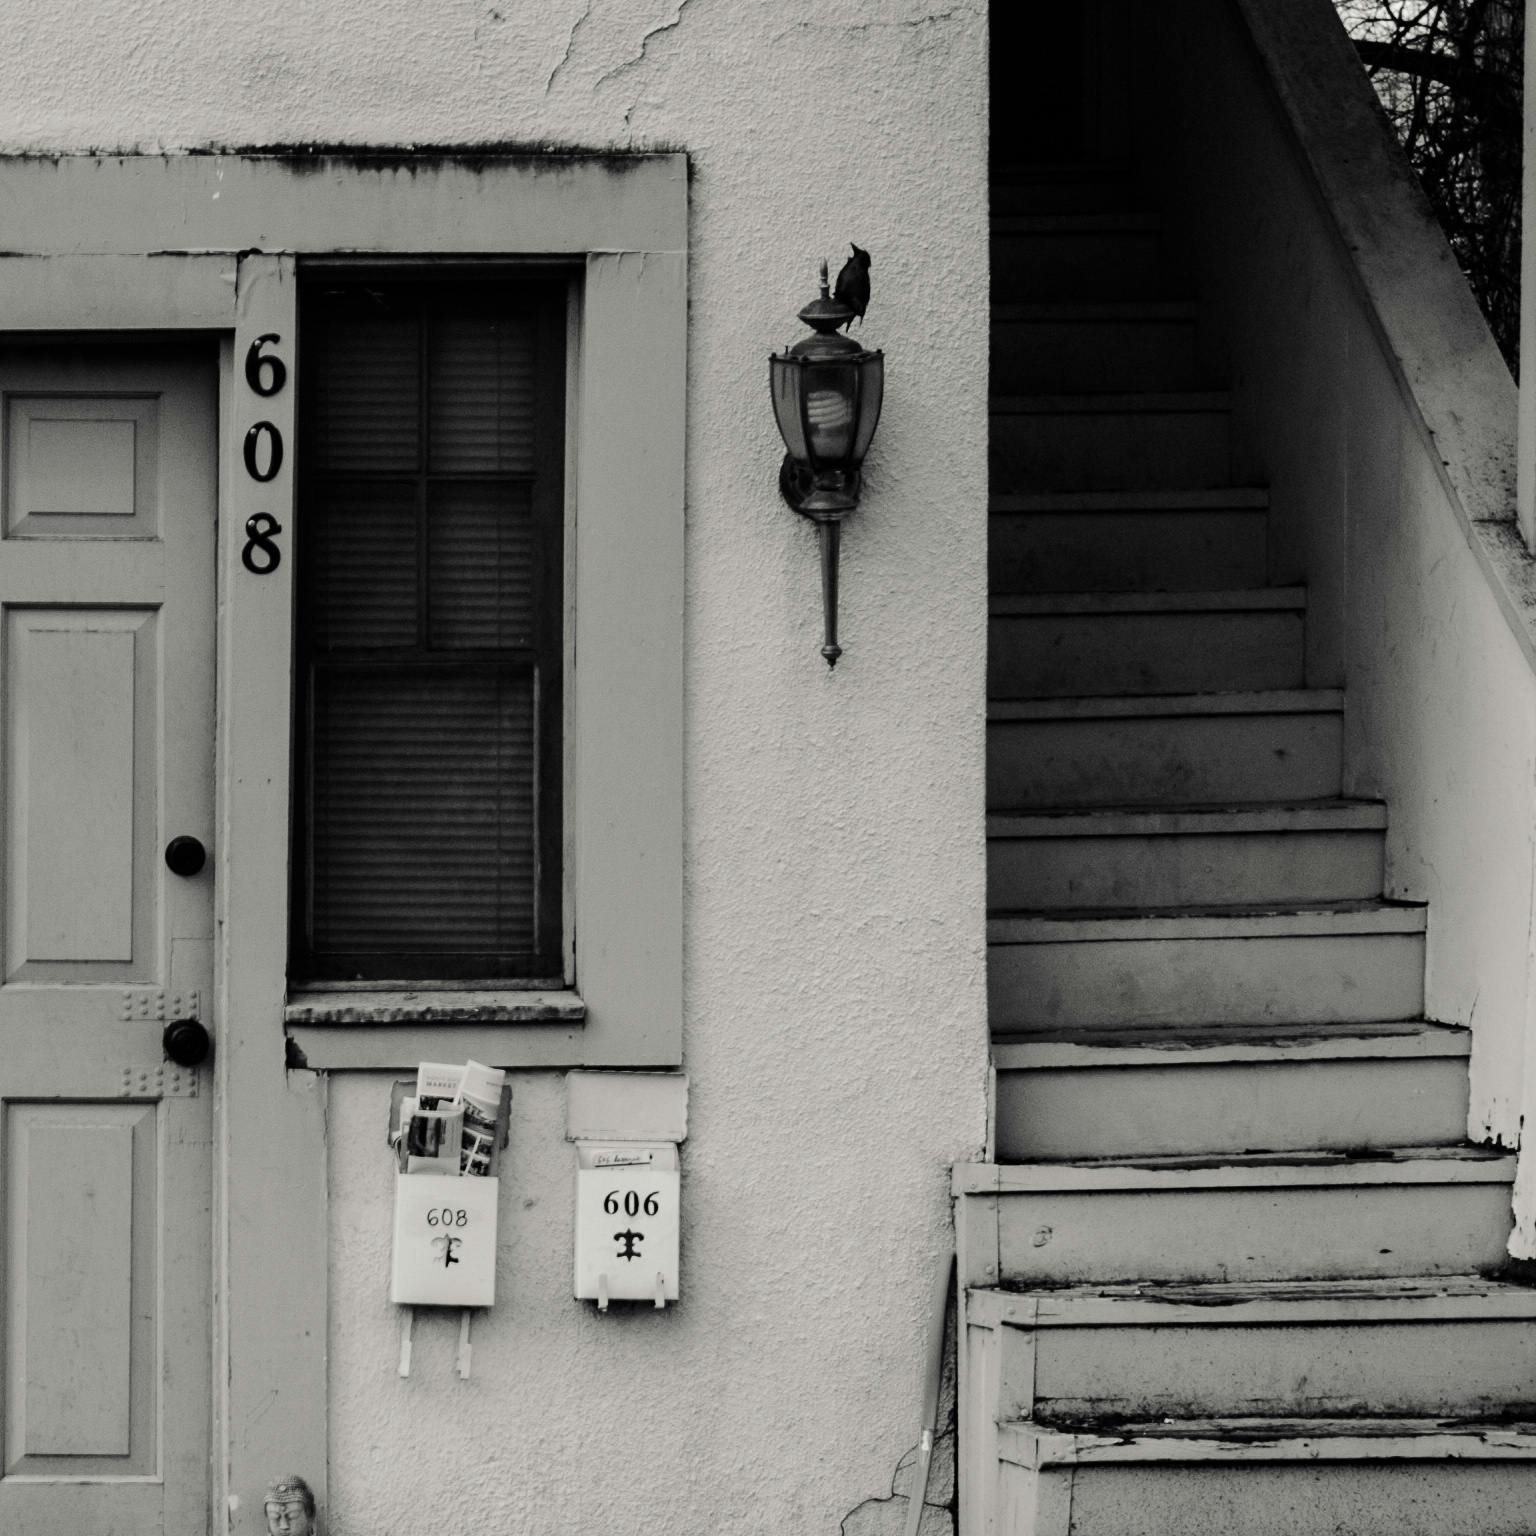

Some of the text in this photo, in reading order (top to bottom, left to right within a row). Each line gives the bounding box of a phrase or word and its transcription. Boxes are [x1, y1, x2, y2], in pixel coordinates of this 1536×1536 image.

[242, 333, 286, 575] 608
[604, 1190, 659, 1217] 606
[427, 1208, 468, 1227] 608
